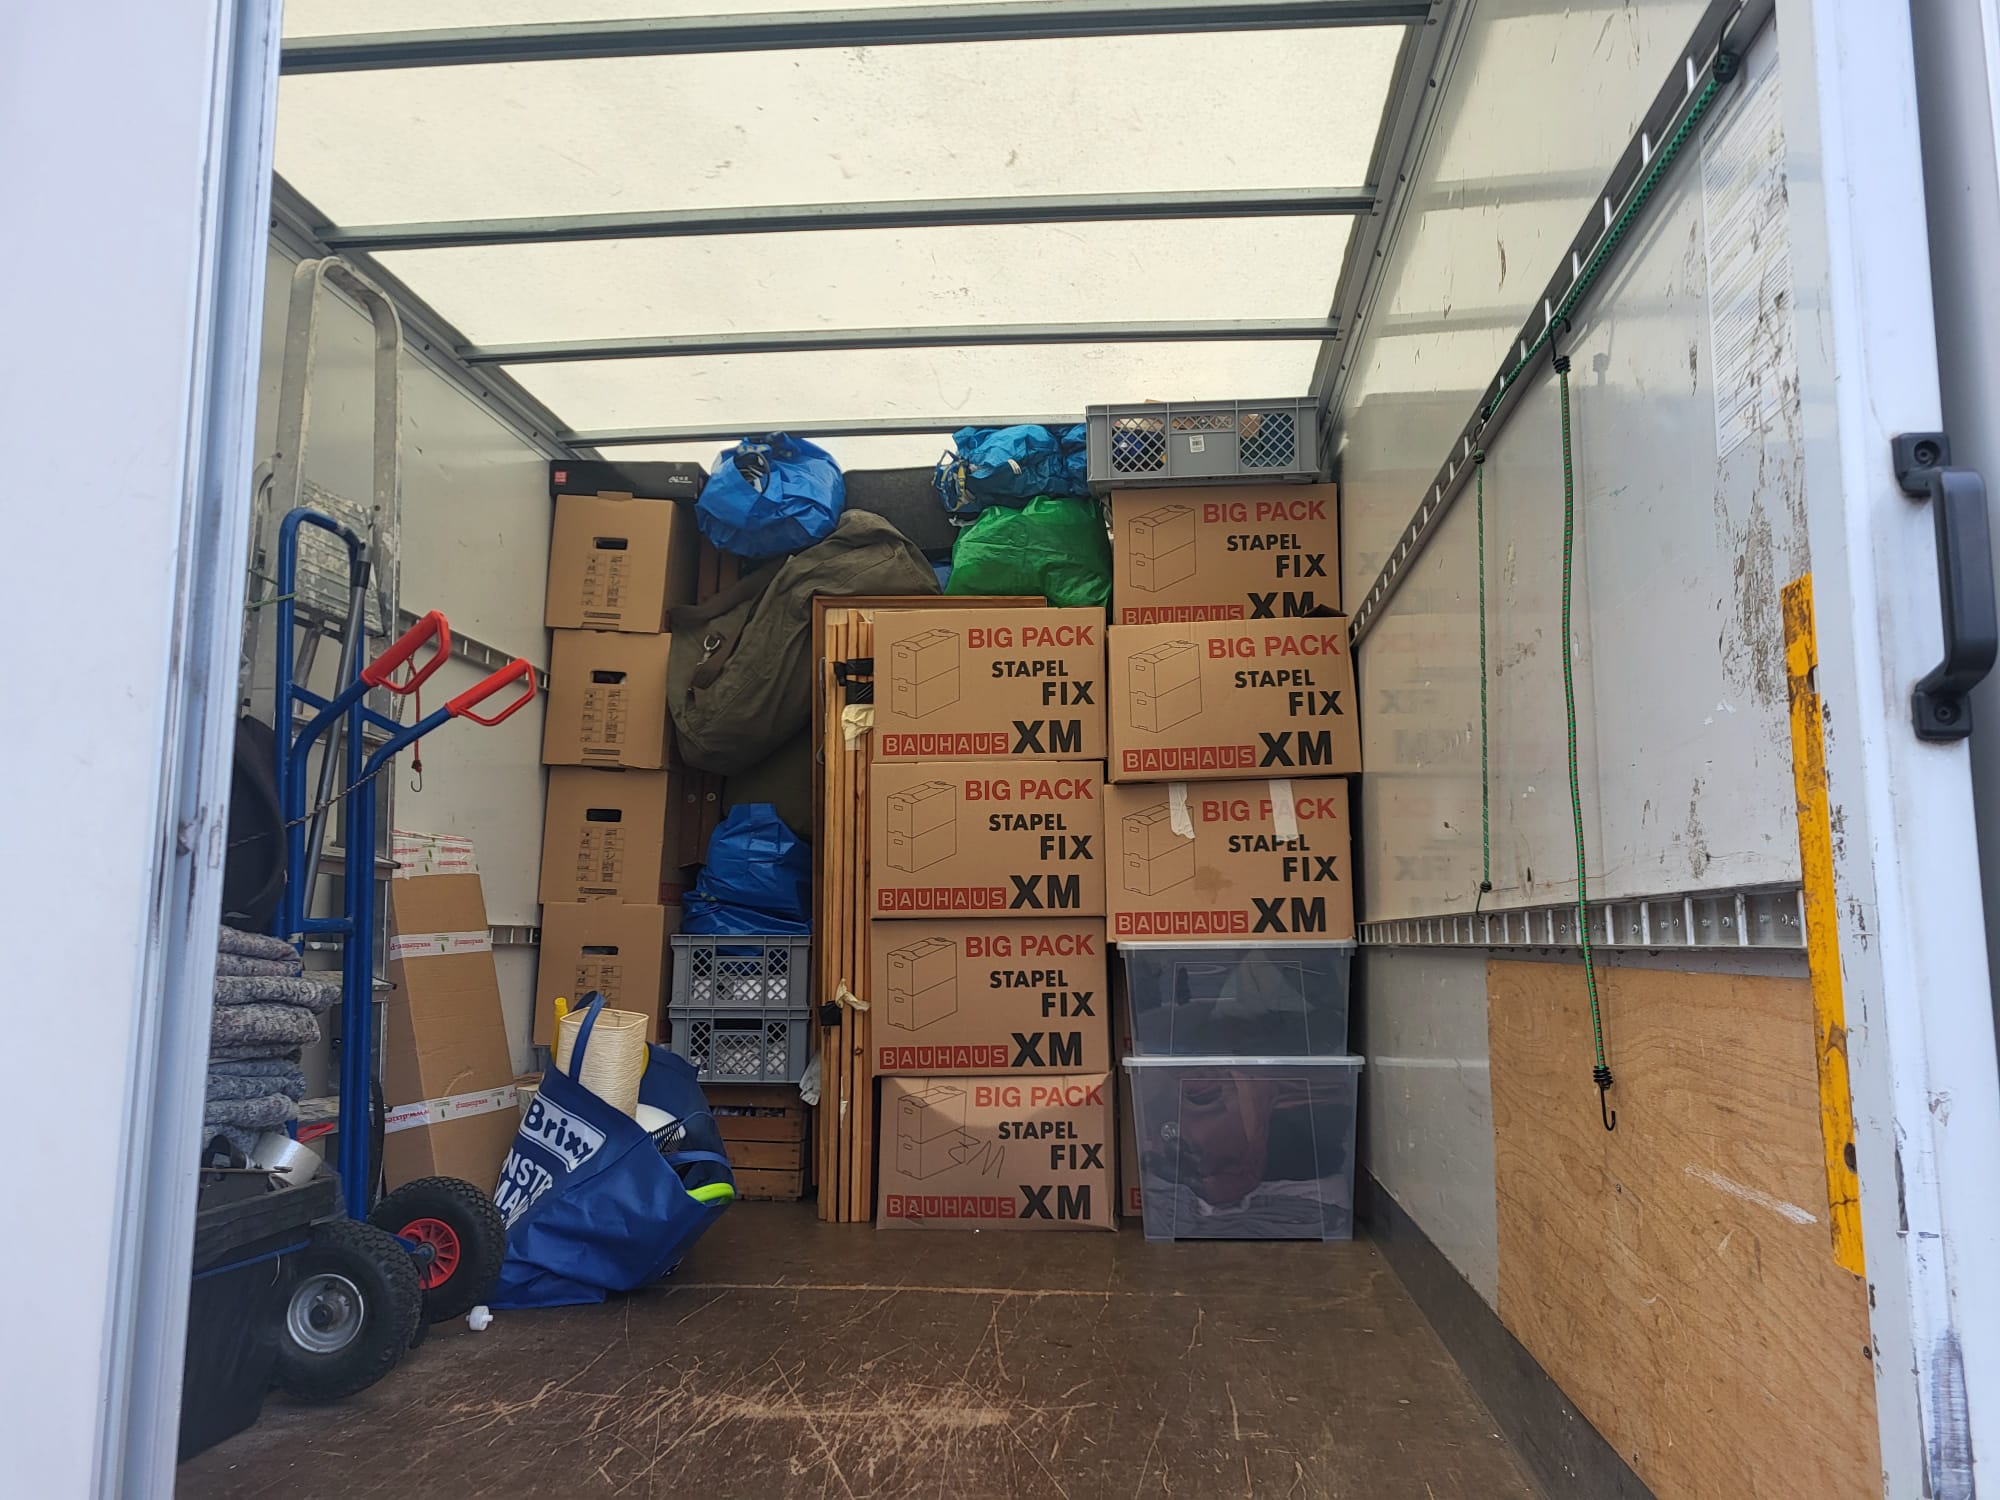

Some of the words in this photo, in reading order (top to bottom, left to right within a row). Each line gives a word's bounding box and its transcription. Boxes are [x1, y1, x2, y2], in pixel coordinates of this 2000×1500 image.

[1202, 502, 1250, 525] BIG
[1255, 500, 1328, 523] PACK
[1226, 533, 1302, 552] STAPEL
[1275, 553, 1328, 579] FIX
[1122, 604, 1245, 625] BAUHAUS
[1247, 591, 1316, 619] XM
[967, 627, 1013, 649] BIG
[1021, 625, 1095, 648] PACK
[1208, 637, 1256, 660] BIG
[1264, 634, 1341, 658] PACK
[991, 660, 1069, 678] STAPEL
[1234, 669, 1316, 688] STAPEL
[1042, 681, 1095, 706] FIX
[1288, 690, 1344, 717] FIX
[882, 732, 1008, 756] BAUHAUS
[1011, 719, 1082, 755] XM
[1258, 730, 1333, 768] XM
[1123, 745, 1257, 773] BAUHAUS
[965, 779, 1011, 801] BIG
[1020, 777, 1094, 800] PACK
[988, 812, 1067, 832] STAPEL
[1202, 799, 1251, 822] BIG
[1259, 797, 1336, 821] PCK
[1040, 835, 1093, 861] FIX
[1228, 833, 1310, 854] STAPEL
[1283, 856, 1340, 883] FIX
[878, 887, 1006, 911] BAUHAUS
[1009, 874, 1080, 909] XM
[1115, 910, 1249, 935] BAUHAUS
[1251, 896, 1327, 933] XM
[965, 935, 1012, 958] BIG
[1021, 934, 1095, 957] PACK
[990, 969, 1068, 989] STAPEL
[1041, 991, 1095, 1018] FIX
[880, 1045, 1009, 1070] BAUHAUS
[1011, 1031, 1082, 1068] XM
[975, 1085, 1022, 1108] BIG
[1030, 1084, 1105, 1107] PACK
[524, 1098, 595, 1164] Brixy
[997, 1121, 1078, 1141] STAPEL
[1050, 1143, 1104, 1170] FIX
[501, 1147, 554, 1206] NSTR
[886, 1194, 1016, 1219] BAUHAUS
[1018, 1185, 1091, 1220] XM
